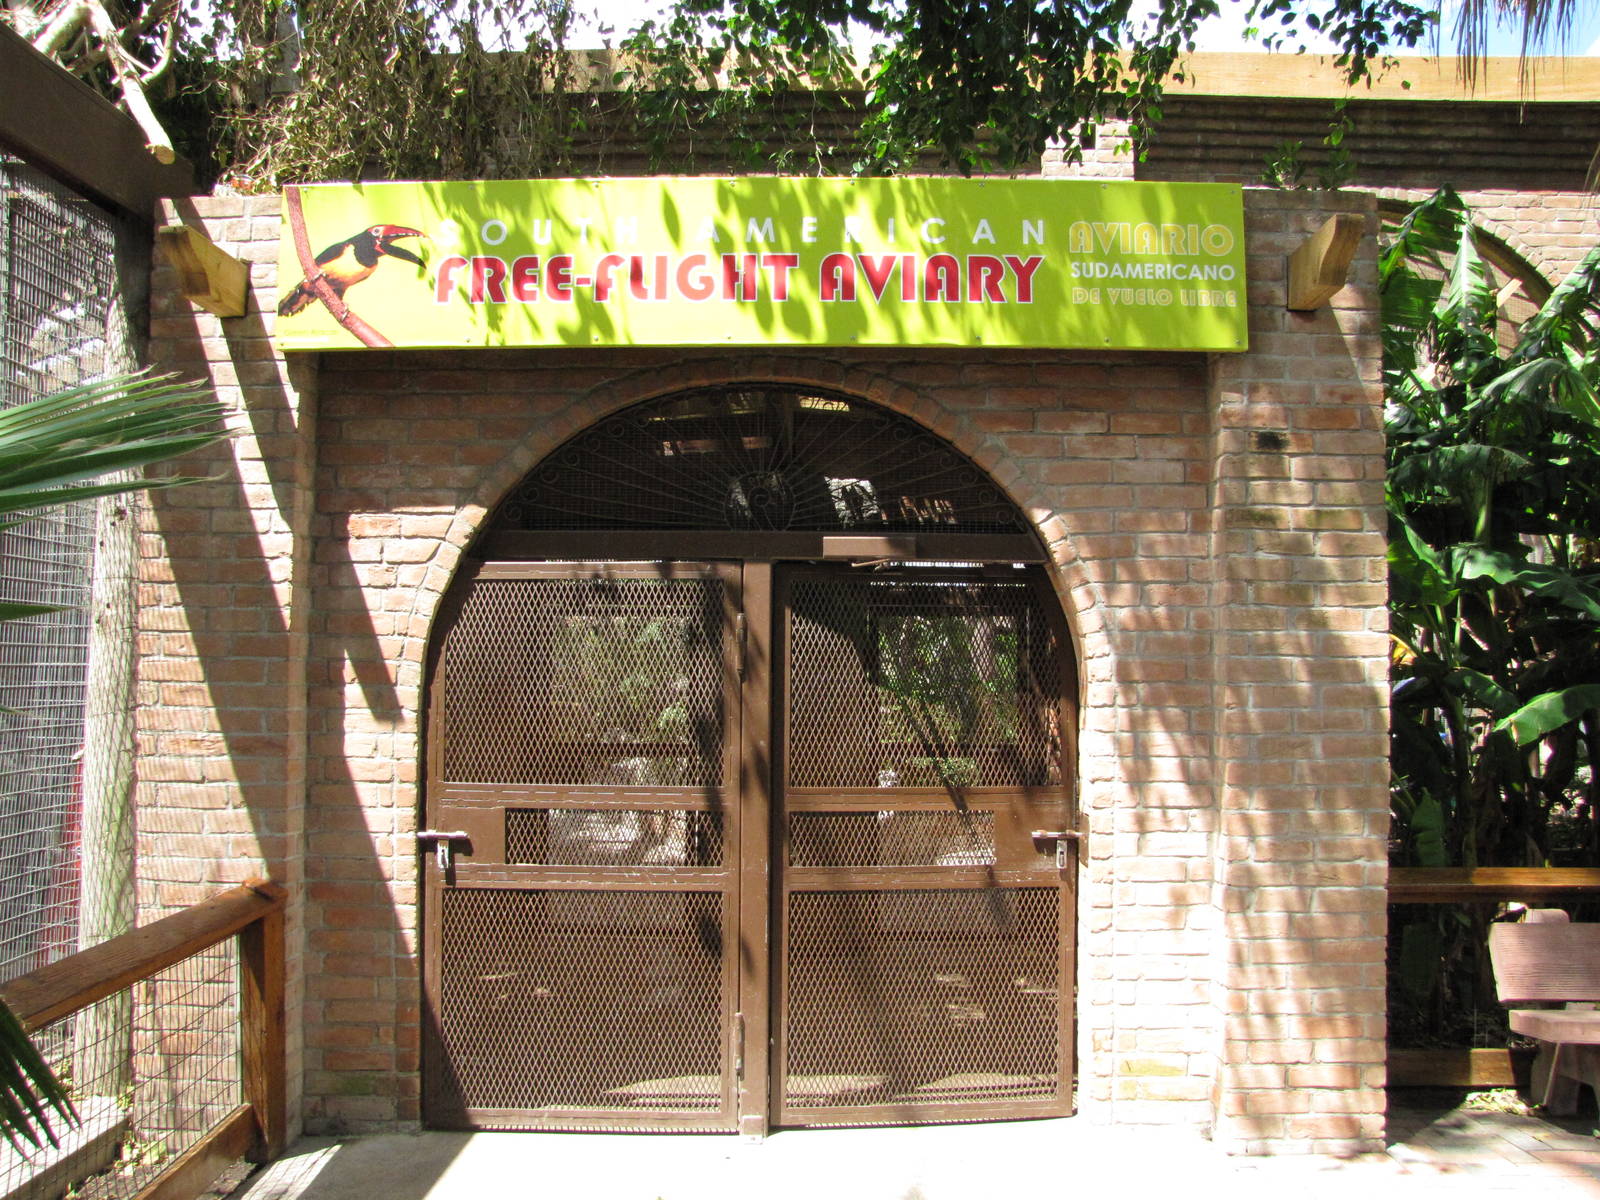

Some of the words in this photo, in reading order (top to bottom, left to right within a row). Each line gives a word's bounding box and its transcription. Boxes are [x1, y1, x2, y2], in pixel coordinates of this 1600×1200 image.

[436, 219, 638, 246] SOUTH
[695, 218, 1046, 245] AMERICAN
[1068, 221, 1235, 257] AVIARIO
[435, 252, 800, 304] FREE-FLIGHT
[819, 252, 1044, 304] AVIARY
[1070, 261, 1236, 281] SUDAMERICANO
[1072, 287, 1101, 305] DE
[1107, 288, 1173, 307] VUELO
[1180, 289, 1238, 307] LIBRE
